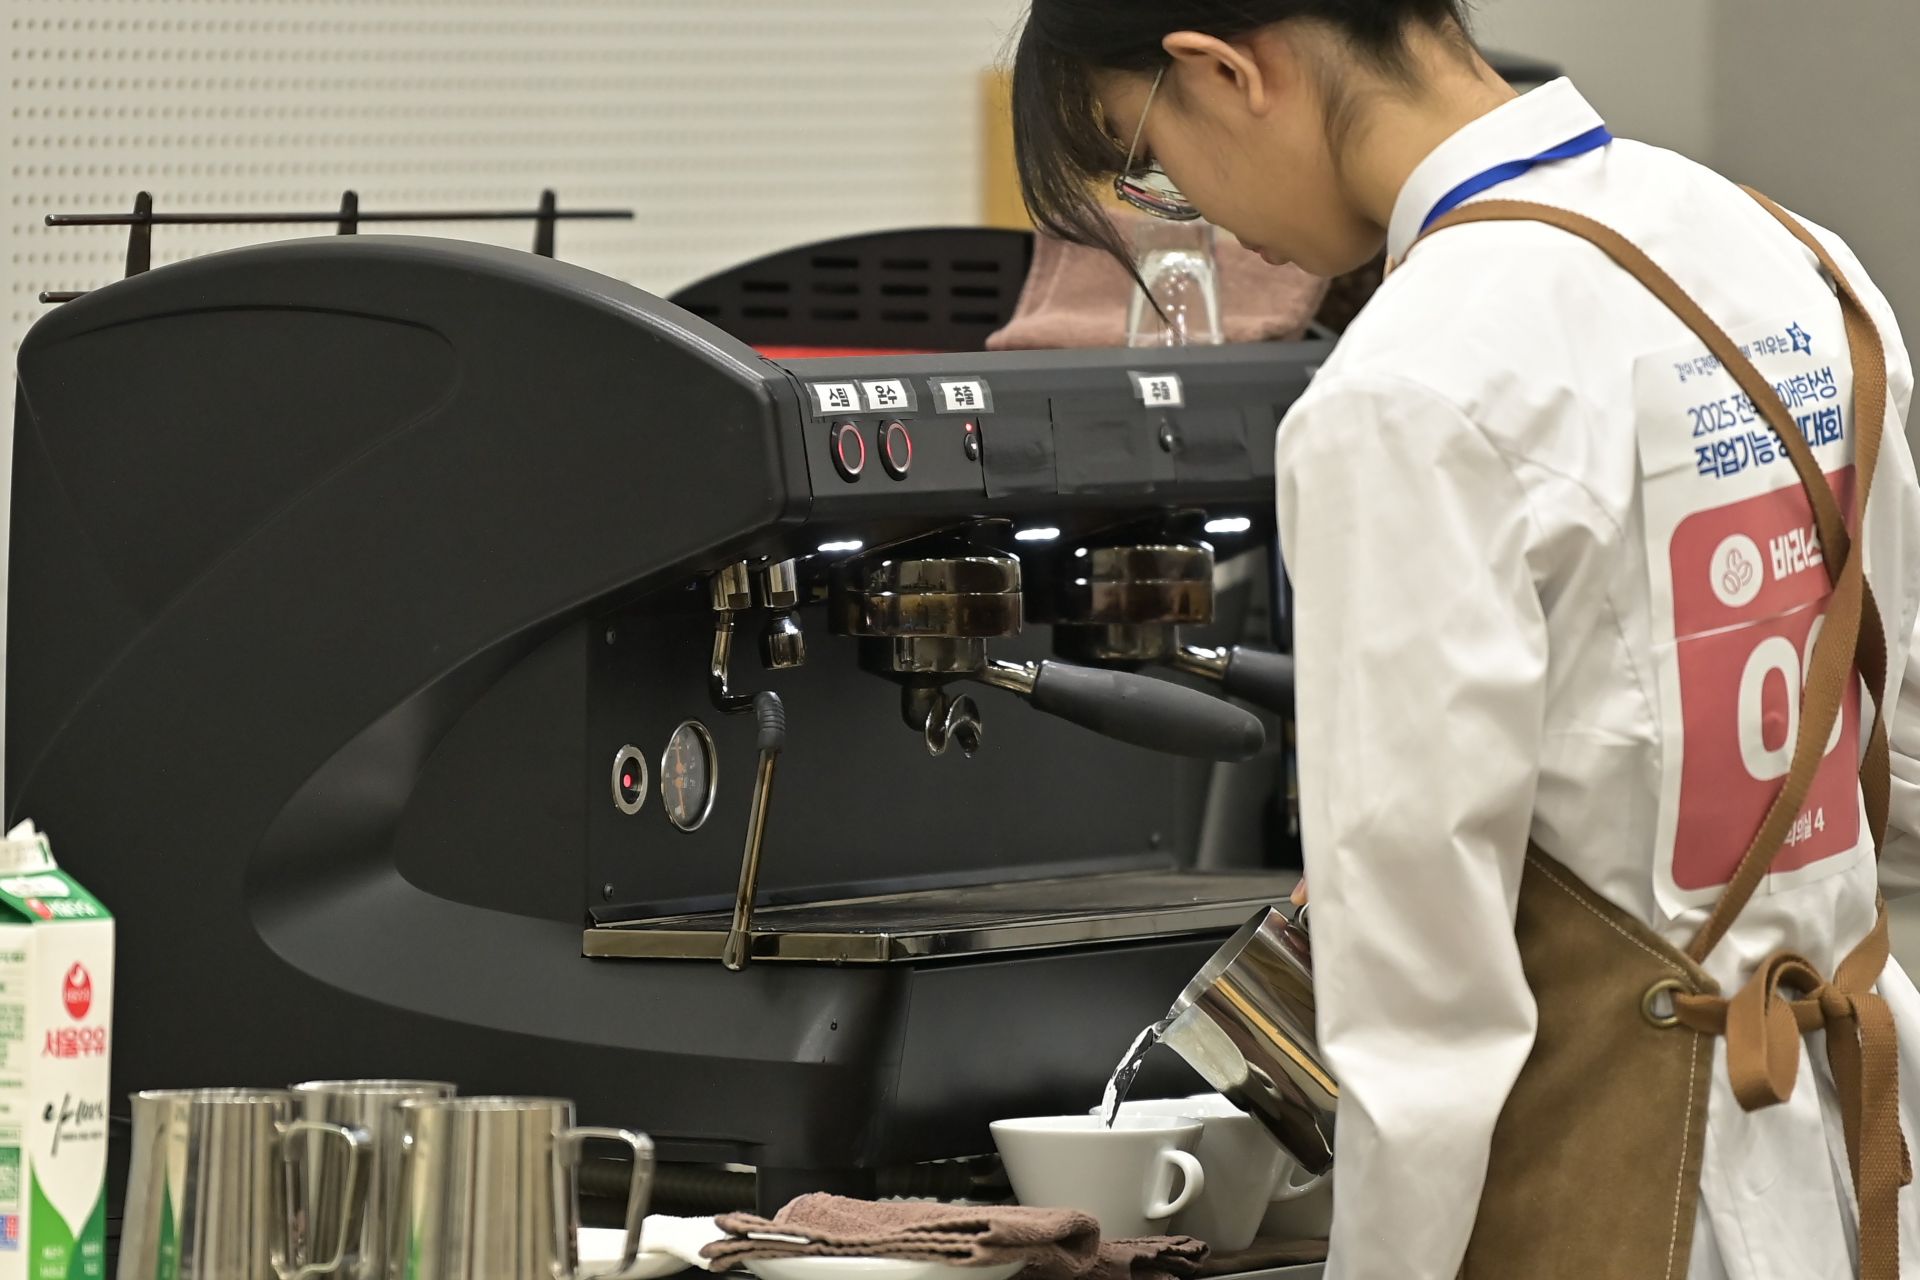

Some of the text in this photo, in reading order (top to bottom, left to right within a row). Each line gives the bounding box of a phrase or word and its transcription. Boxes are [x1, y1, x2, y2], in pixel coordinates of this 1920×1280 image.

[1752, 335, 1790, 356] 키우는
[829, 387, 851, 407] 스팀
[875, 385, 897, 405] 온수
[952, 385, 975, 406] 추출
[1687, 366, 1837, 437] 2025 전애학생
[1694, 404, 1844, 479] 직업기능대회
[1769, 523, 1823, 581] 바리스
[1814, 807, 1825, 832] 4
[43, 1027, 106, 1057] 서울우유
